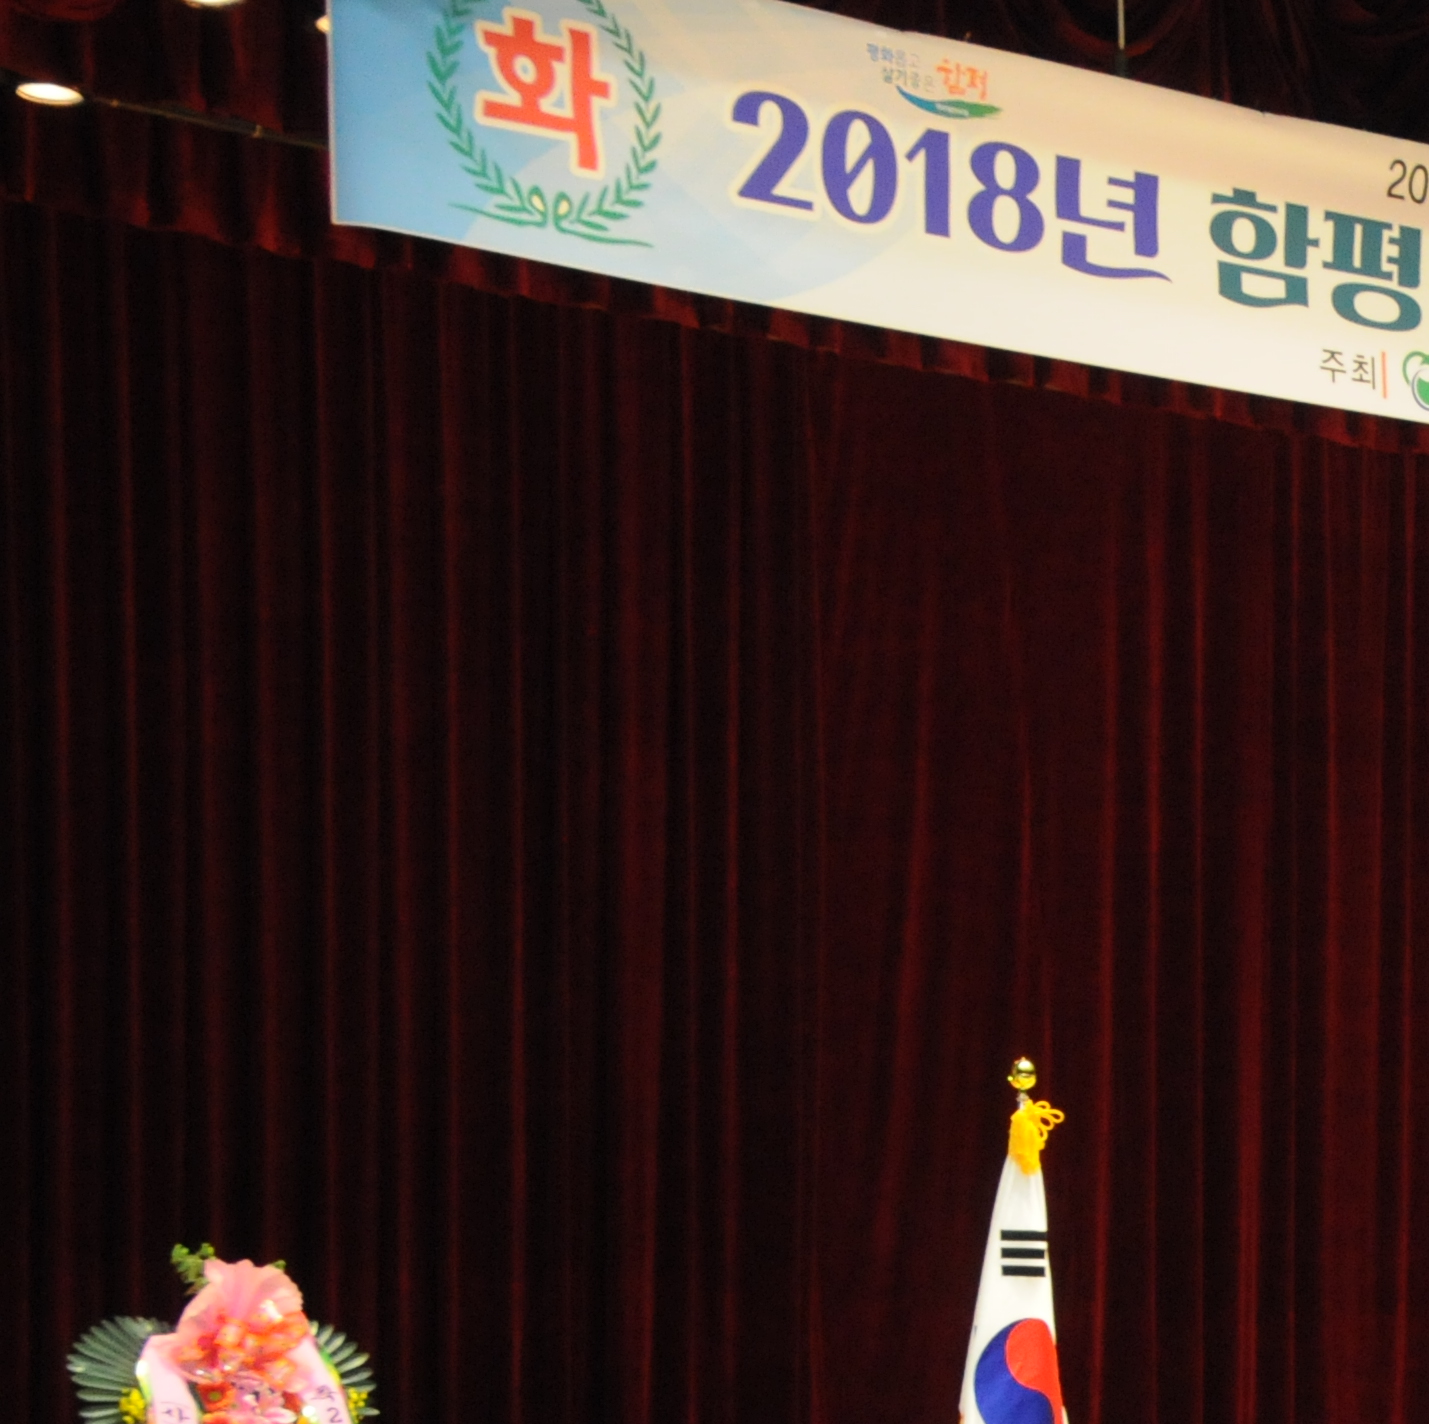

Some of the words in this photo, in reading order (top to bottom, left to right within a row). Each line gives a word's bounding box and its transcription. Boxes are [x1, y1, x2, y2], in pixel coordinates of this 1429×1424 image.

[480, 8, 610, 171] 화
[729, 89, 1172, 282] 2018년
[1319, 349, 1378, 392] 주최
